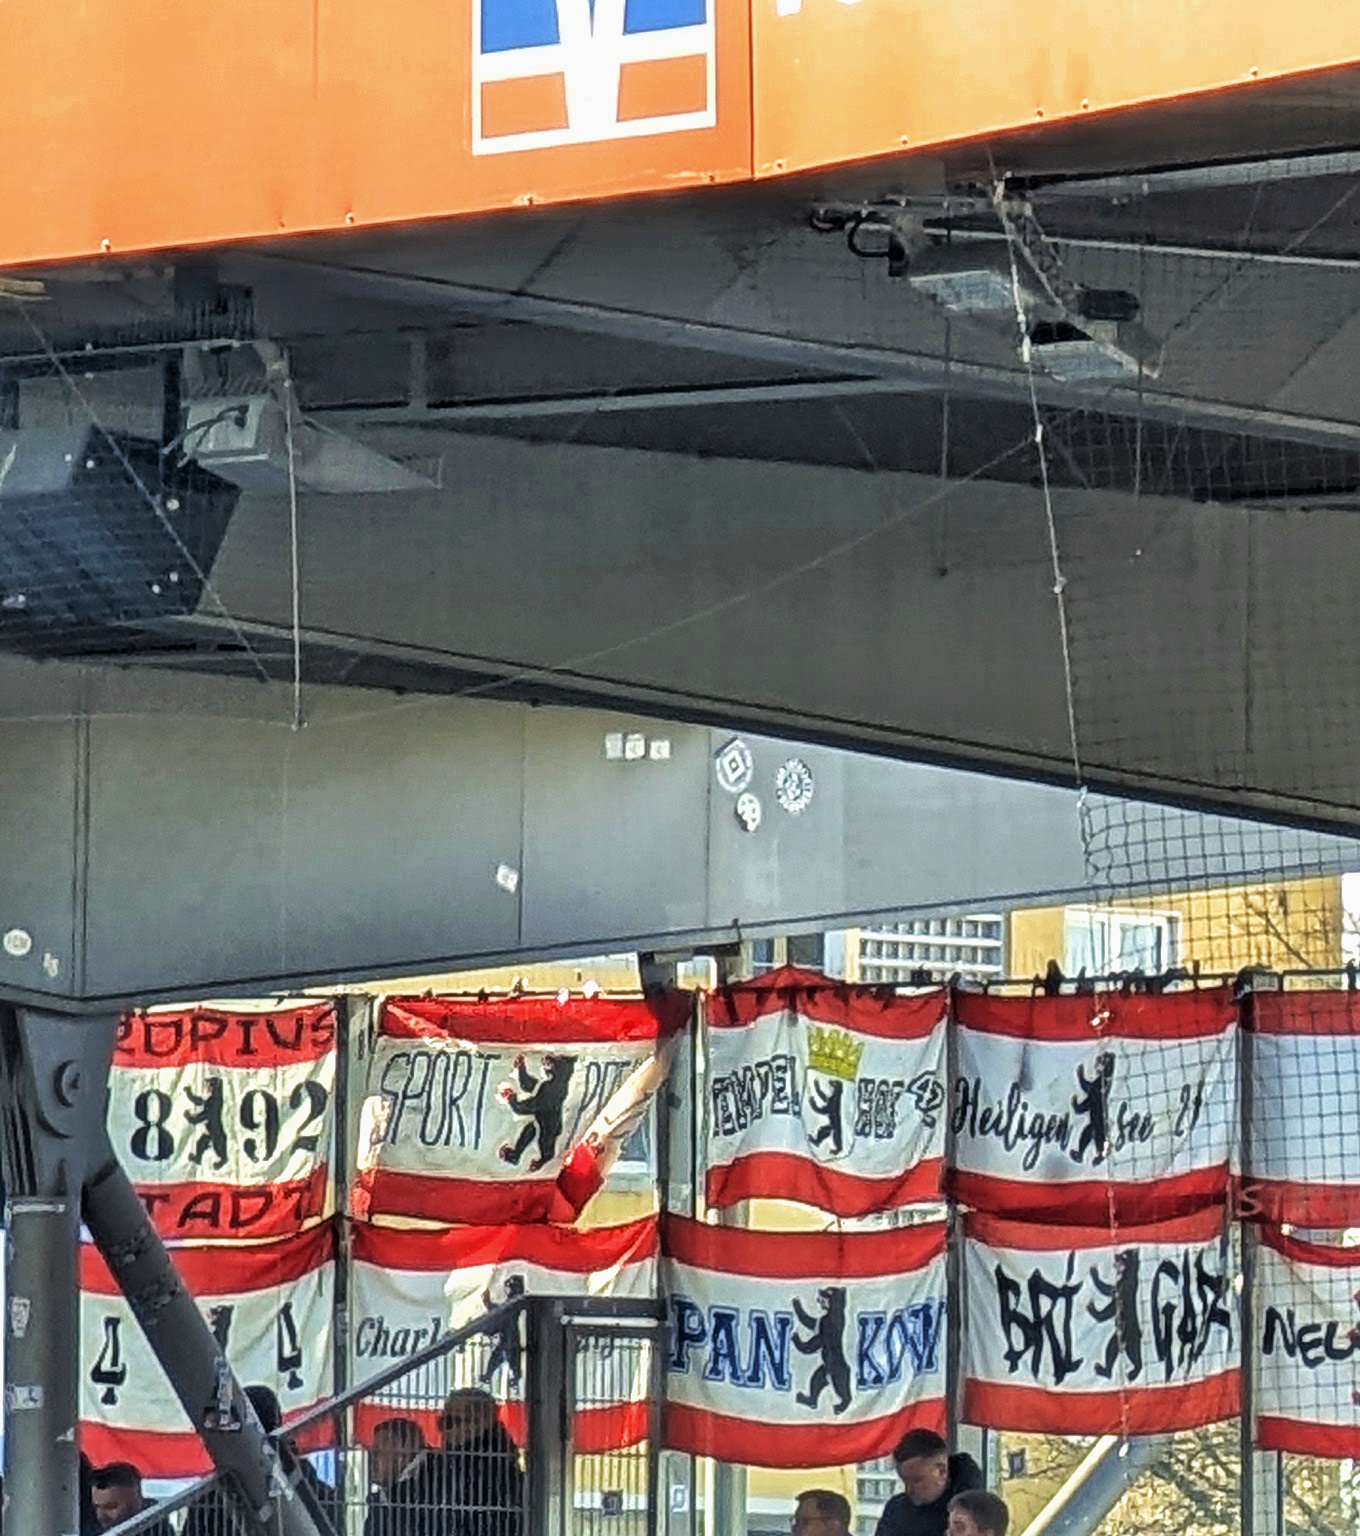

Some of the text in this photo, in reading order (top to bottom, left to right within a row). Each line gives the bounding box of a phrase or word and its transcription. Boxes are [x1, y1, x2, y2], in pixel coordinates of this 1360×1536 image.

[240, 1080, 329, 1163] 92
[370, 1051, 501, 1151] SPORT
[951, 1076, 1070, 1171] Heiligen
[138, 1184, 312, 1229] TADT
[669, 1294, 946, 1391] PAN KOW
